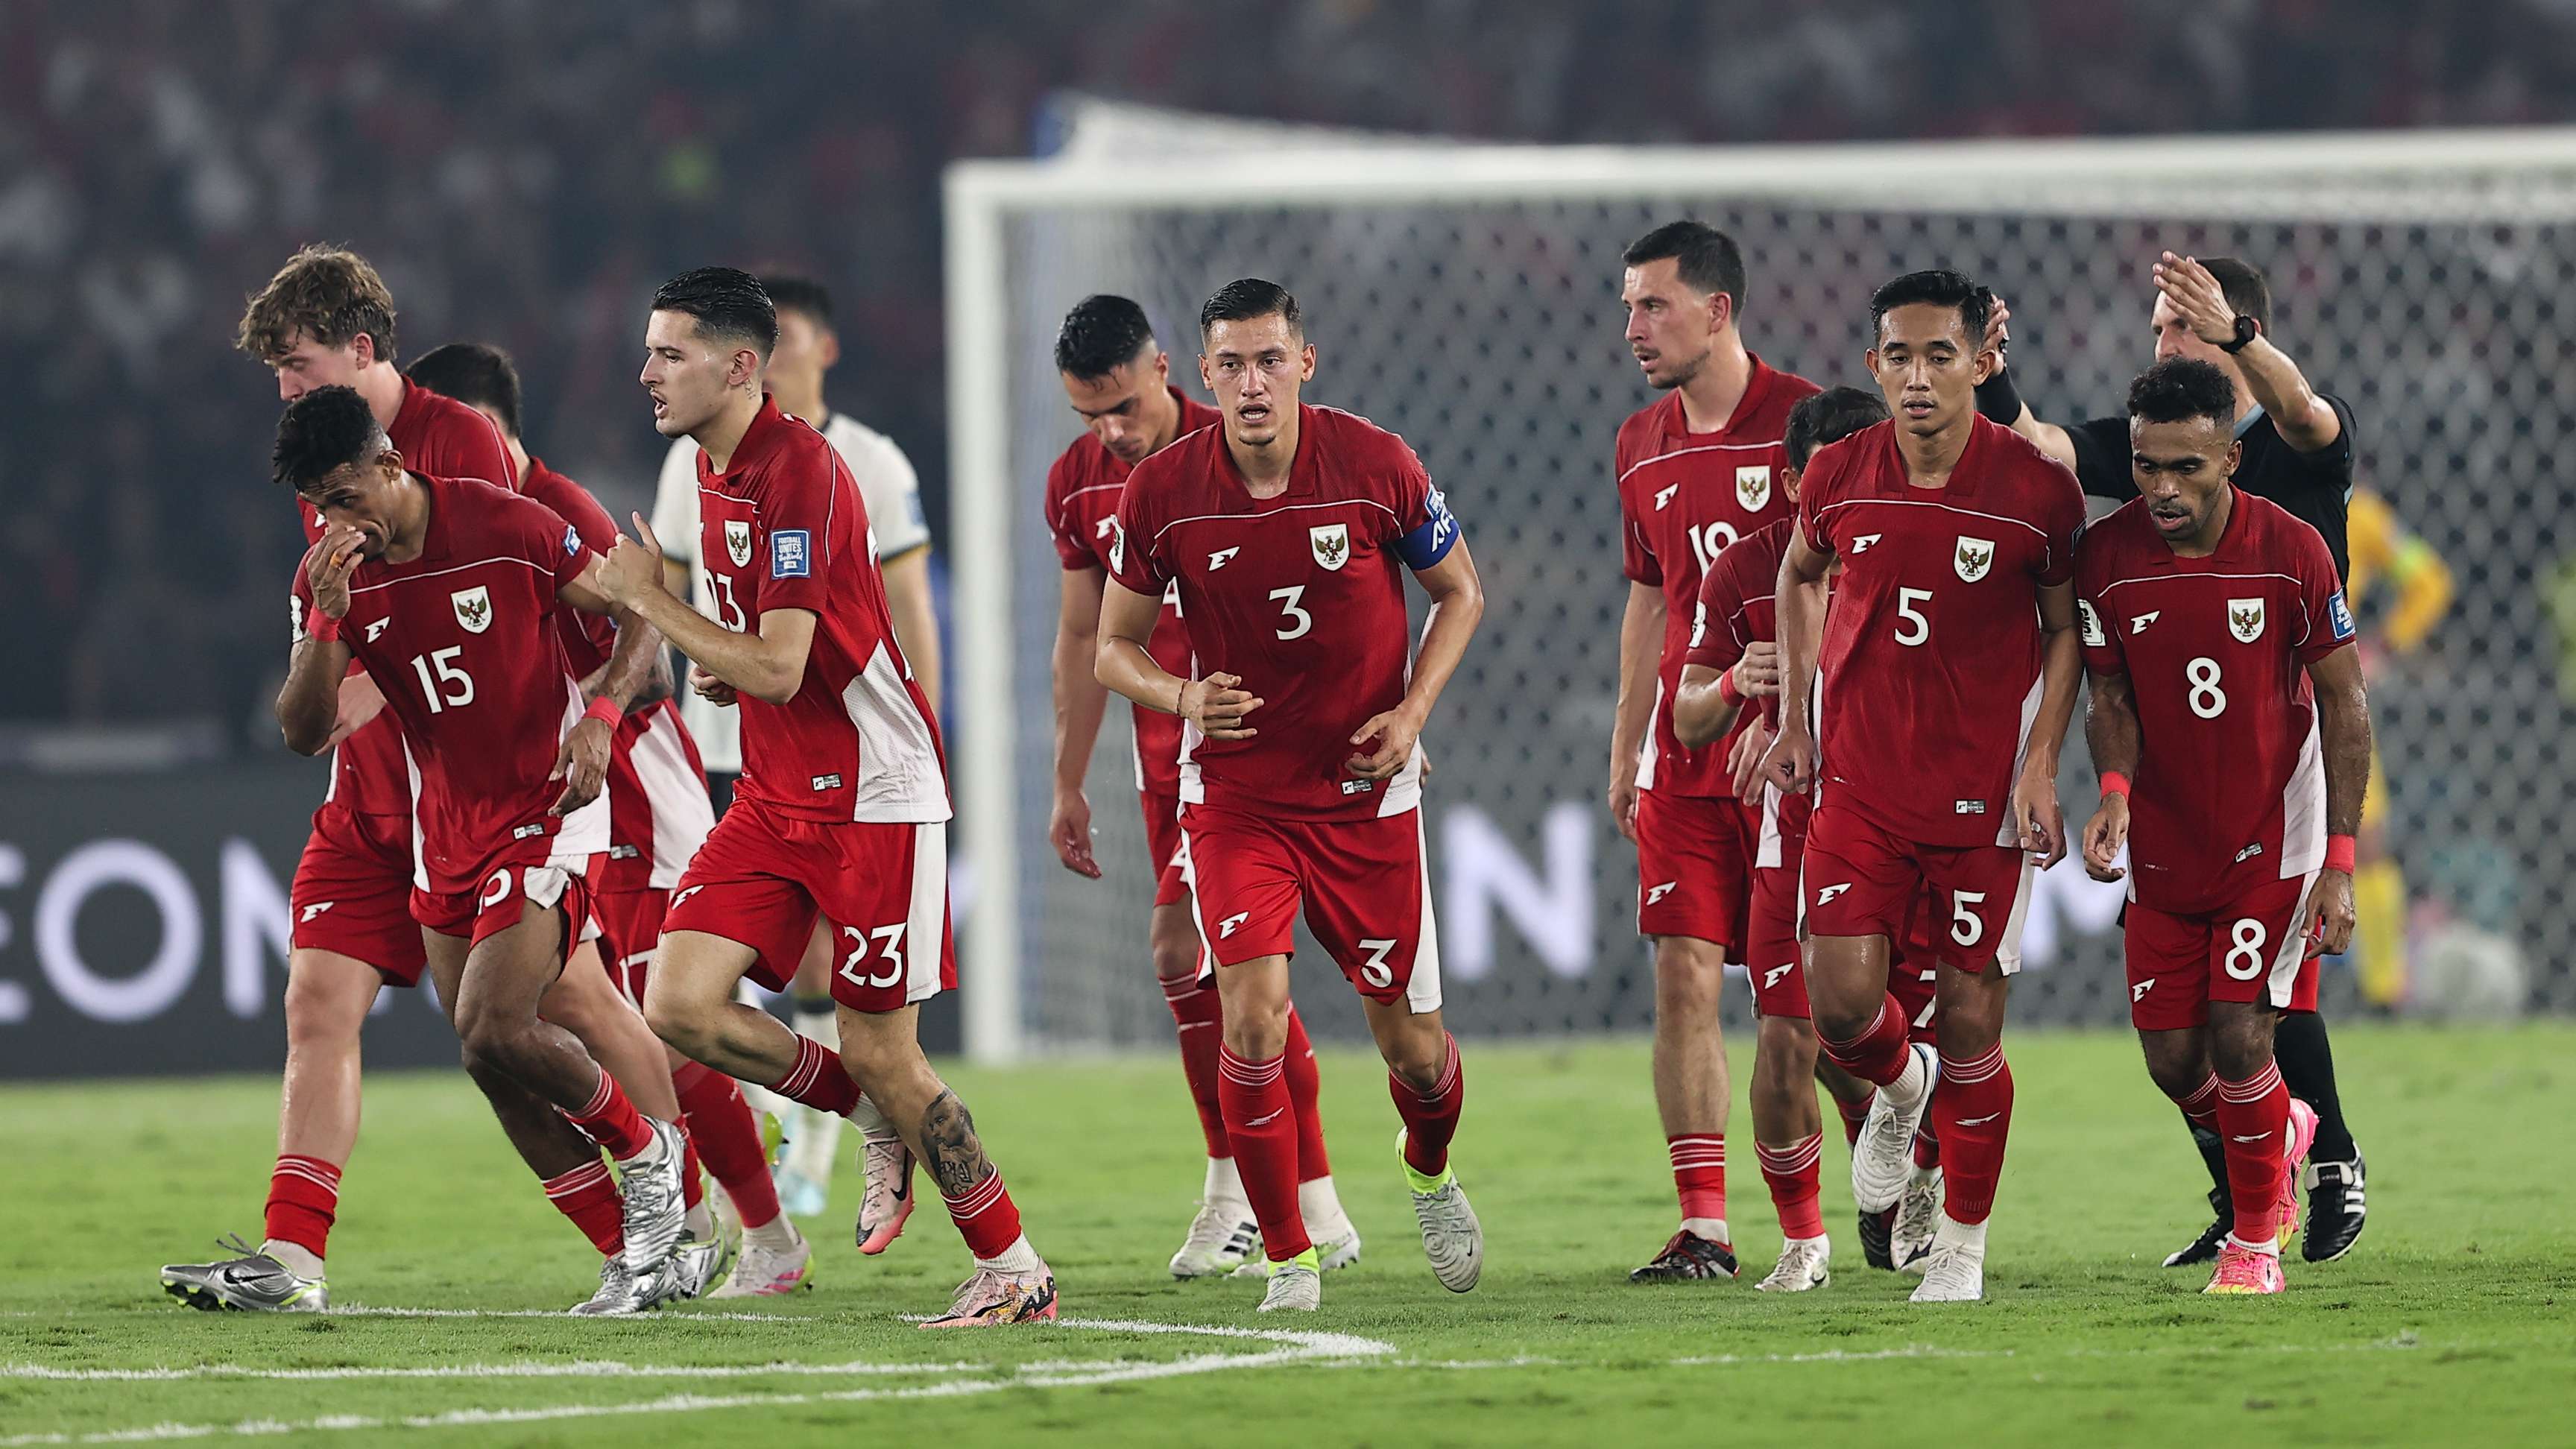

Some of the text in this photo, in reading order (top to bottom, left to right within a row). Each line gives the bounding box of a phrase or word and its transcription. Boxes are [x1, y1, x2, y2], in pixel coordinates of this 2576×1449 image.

[1269, 586, 1312, 640] 3
[1895, 587, 1933, 646] 5
[411, 645, 475, 713] 15
[2187, 657, 2226, 719] 8
[1951, 890, 1986, 946] 5
[839, 923, 906, 988] 23
[1358, 939, 1398, 988] 3
[2225, 918, 2266, 980] 8
